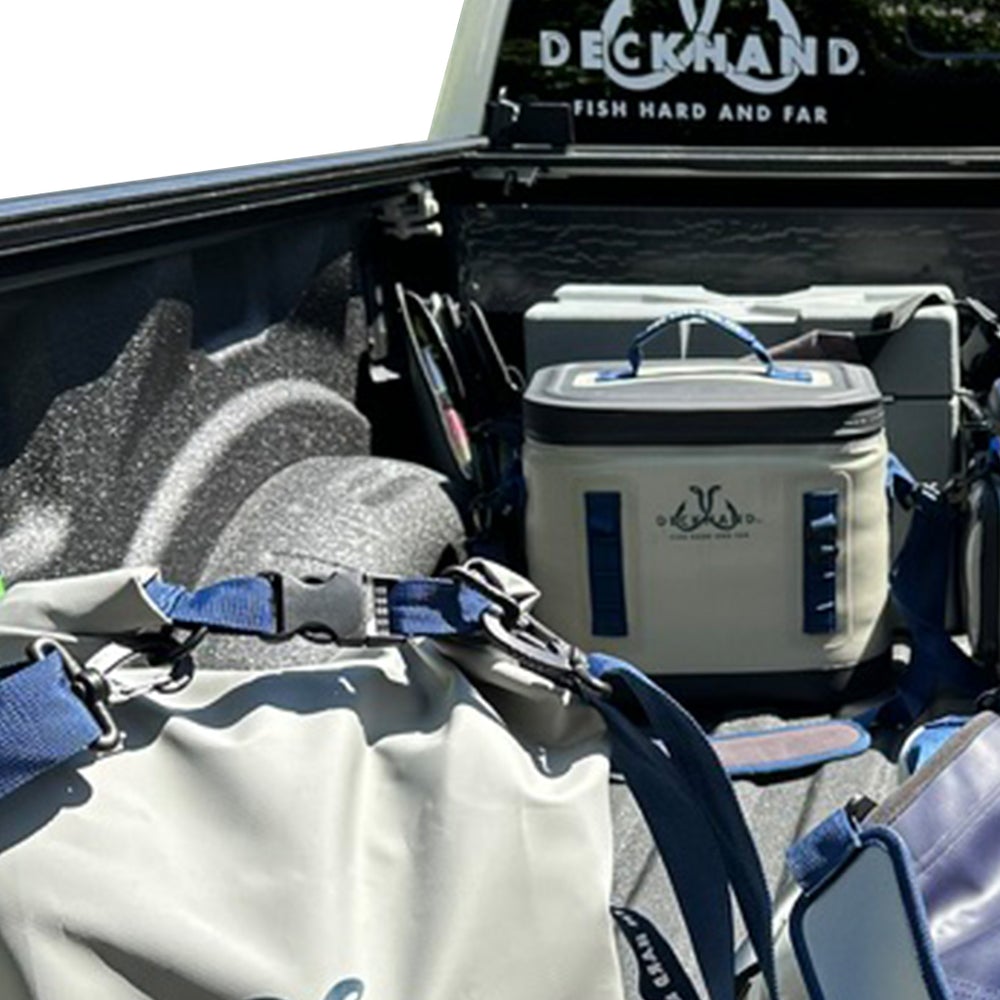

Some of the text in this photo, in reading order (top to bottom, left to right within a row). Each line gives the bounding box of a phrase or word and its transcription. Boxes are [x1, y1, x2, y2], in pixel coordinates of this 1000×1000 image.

[539, 30, 860, 76] DECKHAND
[573, 100, 828, 124] FISH HARD AND FAR
